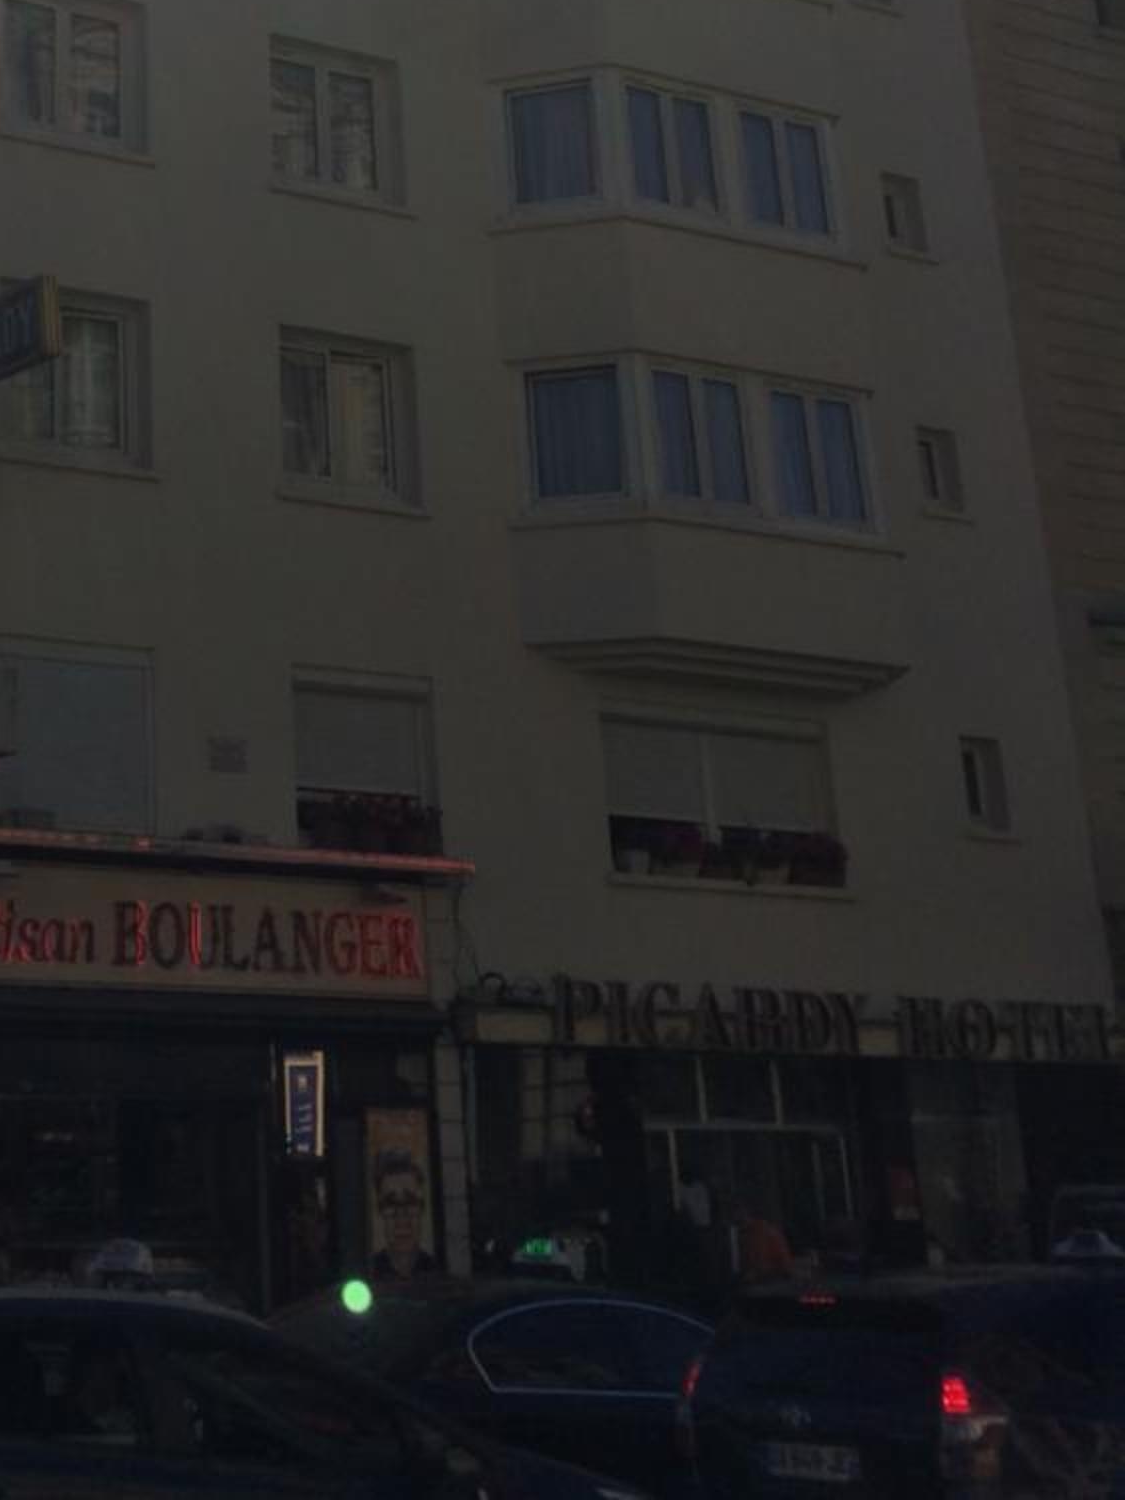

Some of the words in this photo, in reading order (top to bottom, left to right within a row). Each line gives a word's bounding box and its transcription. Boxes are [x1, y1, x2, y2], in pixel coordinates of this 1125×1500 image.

[111, 900, 422, 979] BOULANGER
[554, 974, 865, 1057] PICARDY
[897, 996, 1119, 1061] HOTEL
